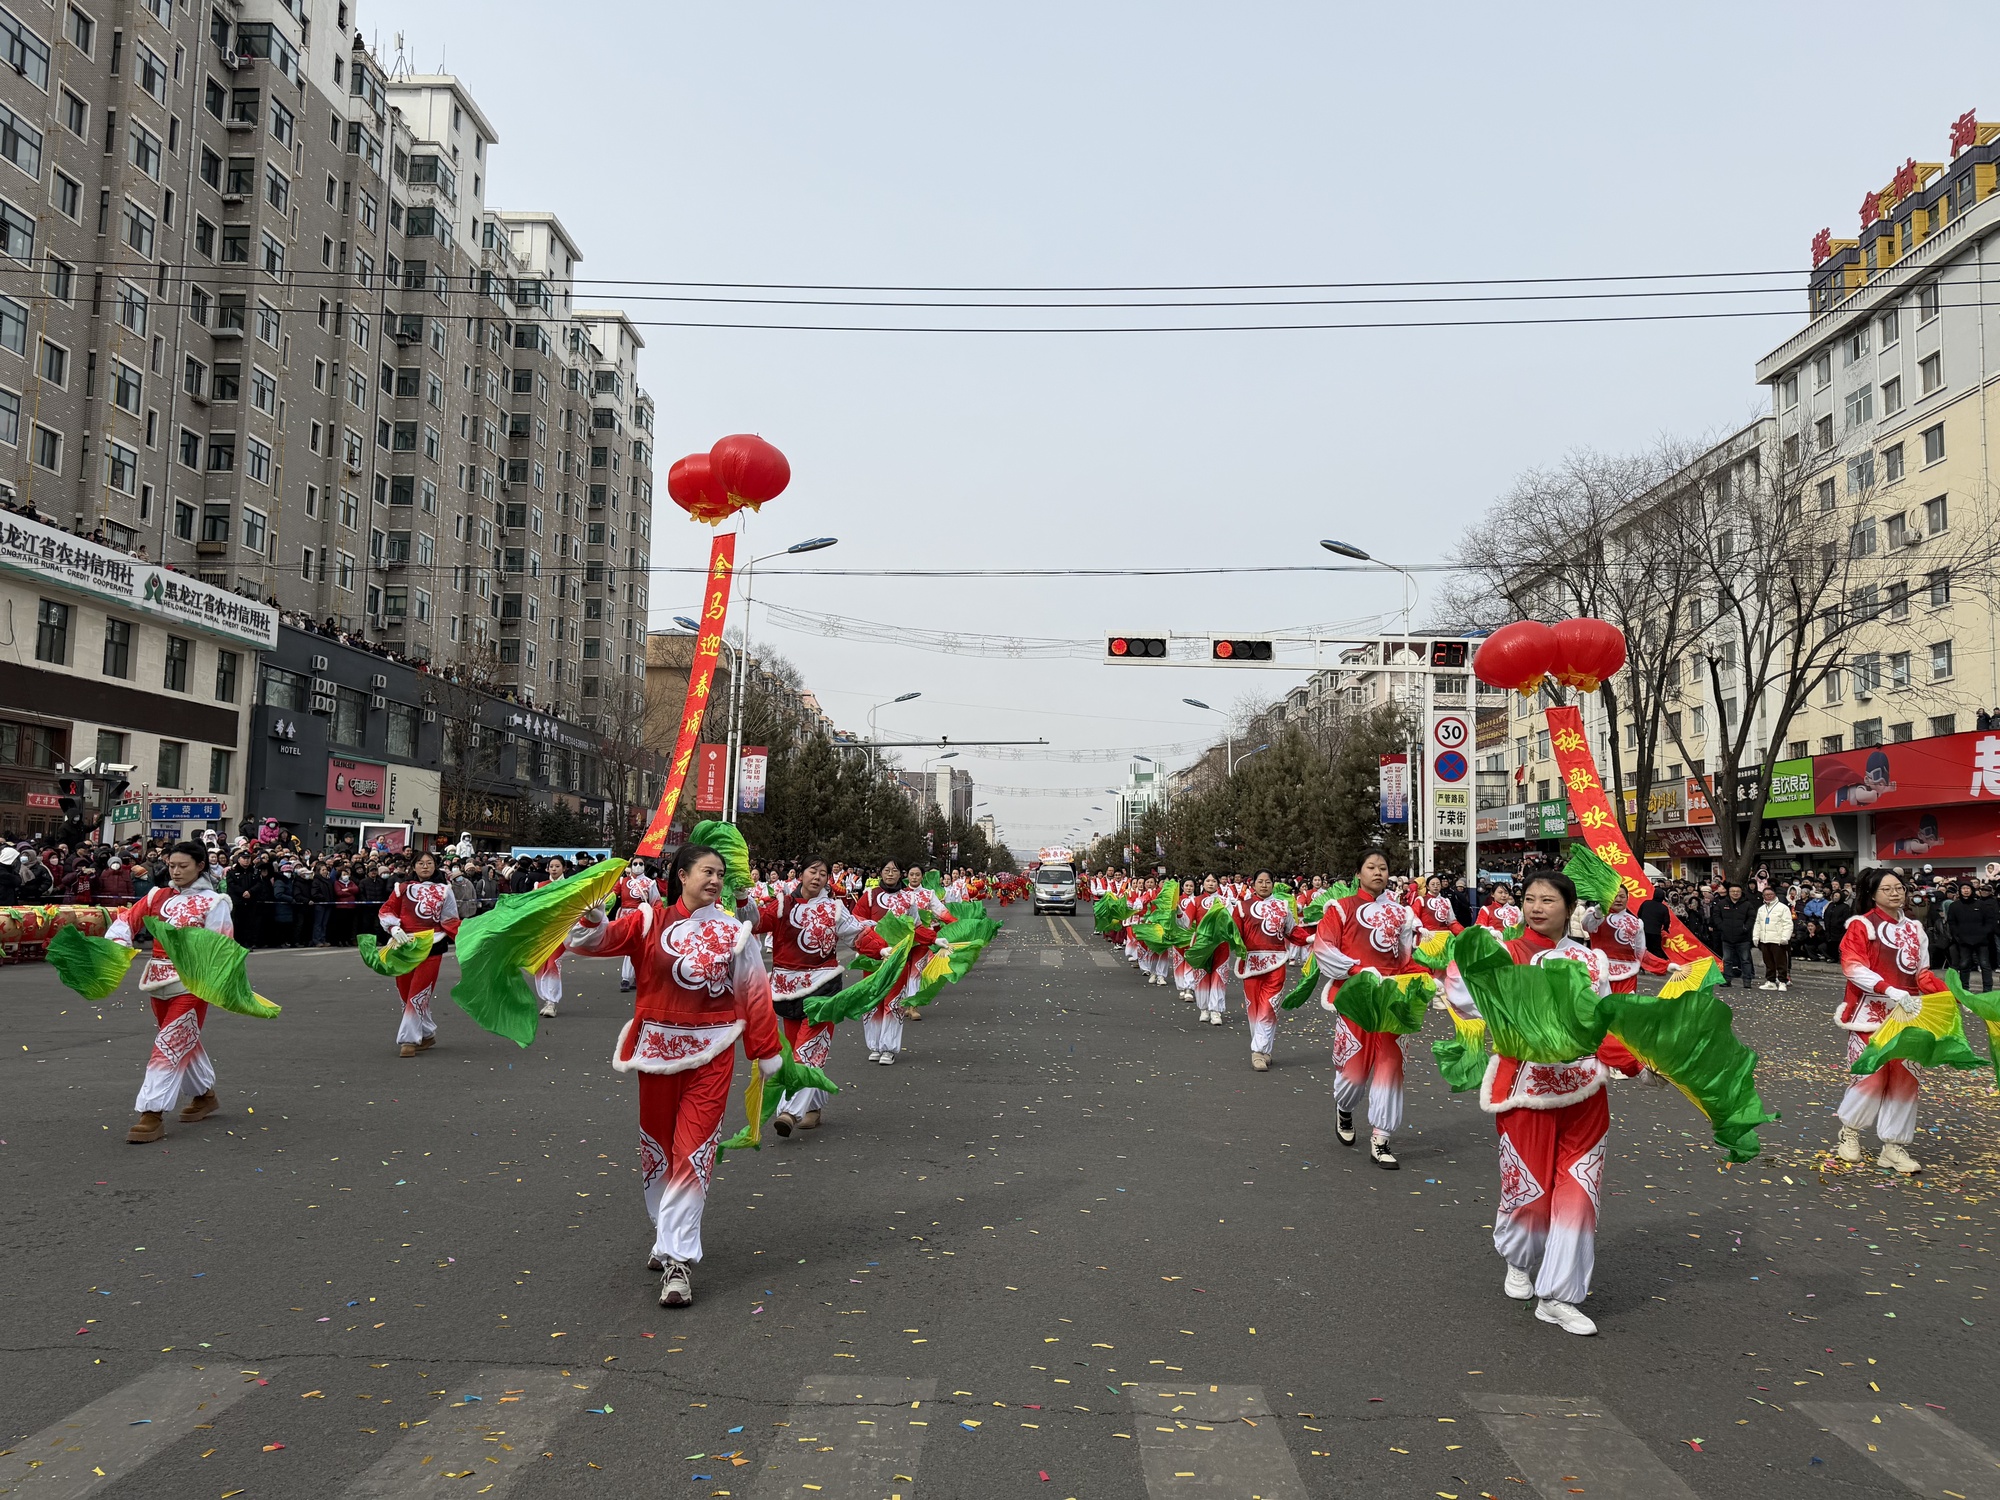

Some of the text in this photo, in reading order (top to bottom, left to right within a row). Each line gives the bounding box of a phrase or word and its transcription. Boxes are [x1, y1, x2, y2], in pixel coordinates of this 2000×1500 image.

[41, 561, 63, 573] RURAL
[67, 569, 90, 583] CREDIT
[93, 577, 133, 595] COOPERATIVE
[164, 580, 271, 632] 黑龙江省农村信用社
[164, 600, 270, 640] HEILONGJIANG RURAL CREDIT COOPERATIVE
[1434, 643, 1464, 665] 27
[664, 552, 733, 816] 金马迎春闹元宵
[274, 718, 297, 739] 希金
[1441, 725, 1462, 740] 30
[280, 745, 301, 756] HOTEL
[1771, 774, 1810, 795] 吾饮良品
[1437, 793, 1465, 804] 严管路段
[160, 805, 213, 814] 子荣街
[1437, 810, 1466, 826] 子荣街
[1553, 727, 1698, 953] 秧歌欢腾启程
